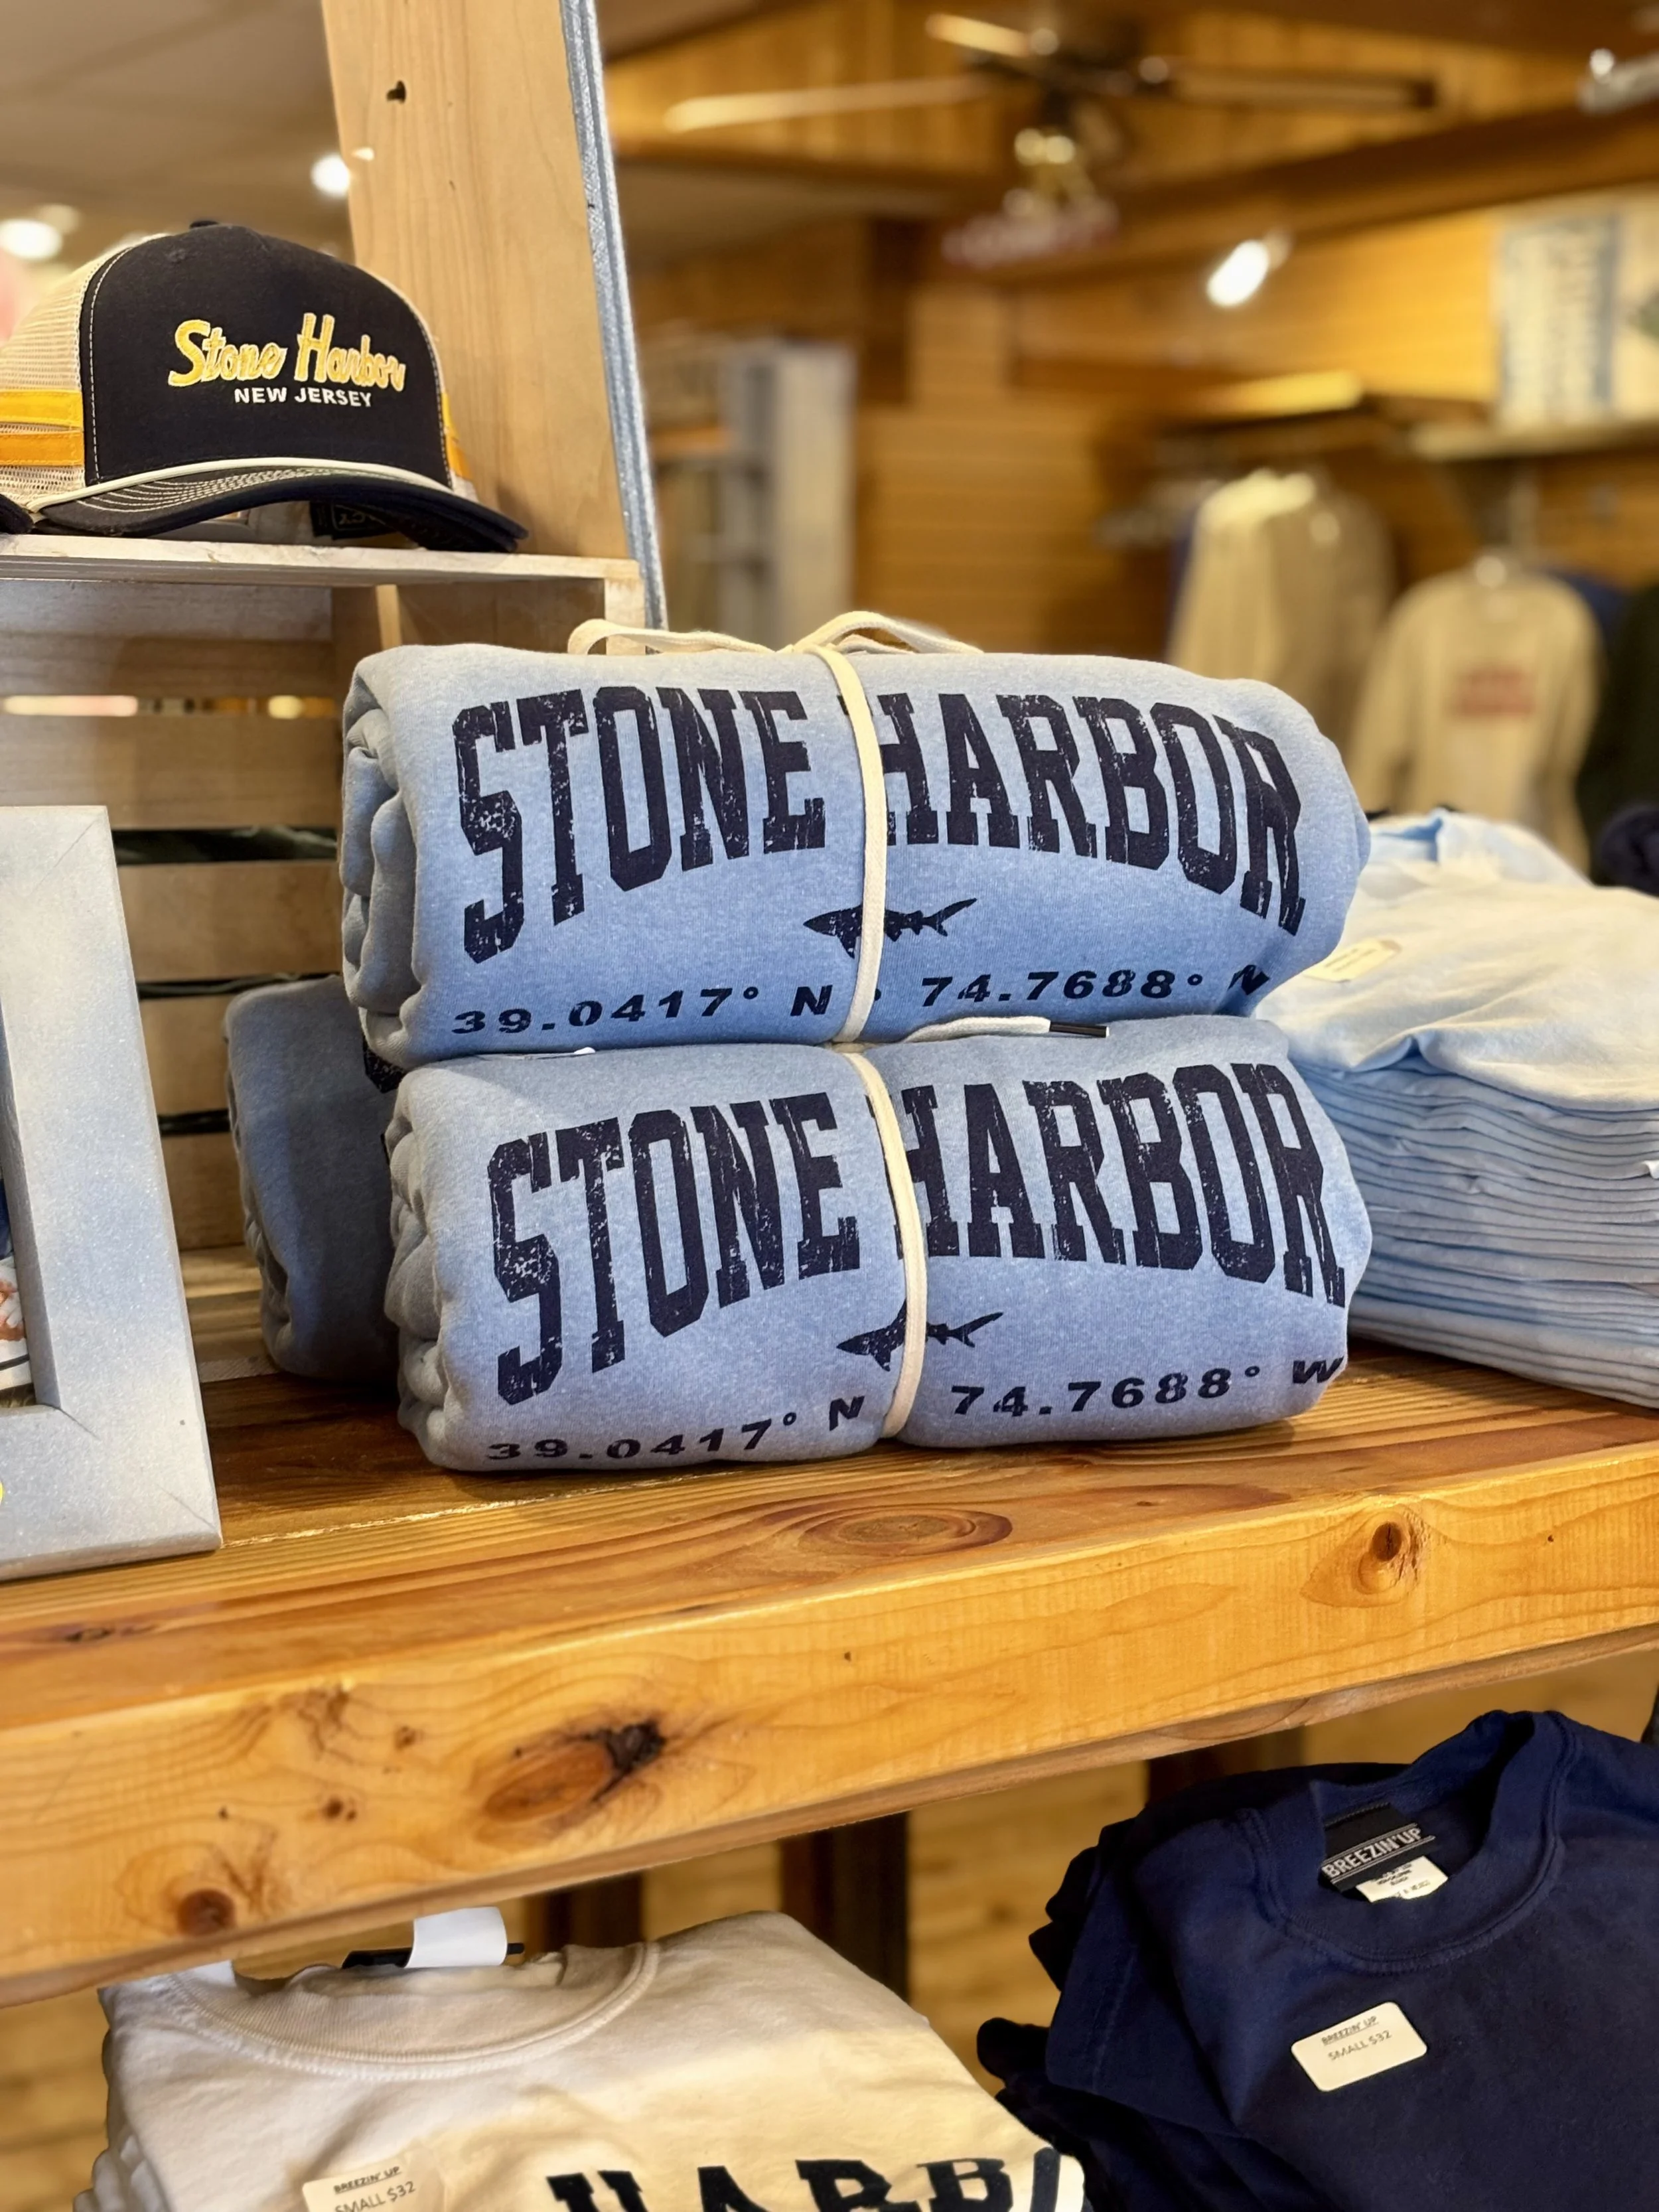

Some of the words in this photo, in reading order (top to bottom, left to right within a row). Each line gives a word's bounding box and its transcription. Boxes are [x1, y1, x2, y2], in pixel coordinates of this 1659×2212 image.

[168, 319, 288, 386] Stone
[294, 313, 406, 392] Harbor
[234, 388, 287, 403] NEW
[295, 388, 372, 407] JERSEY
[453, 686, 826, 964] STONE
[837, 692, 1306, 936] HARBOR
[790, 984, 833, 1016] N
[487, 1092, 859, 1405] STONE
[865, 1062, 1346, 1308] HARBOR
[830, 1396, 865, 1432] N
[1292, 1355, 1344, 1384] W
[1328, 2040, 1369, 2061] SMALL
[384, 2166, 401, 2177] UP
[387, 2181, 416, 2202] $32
